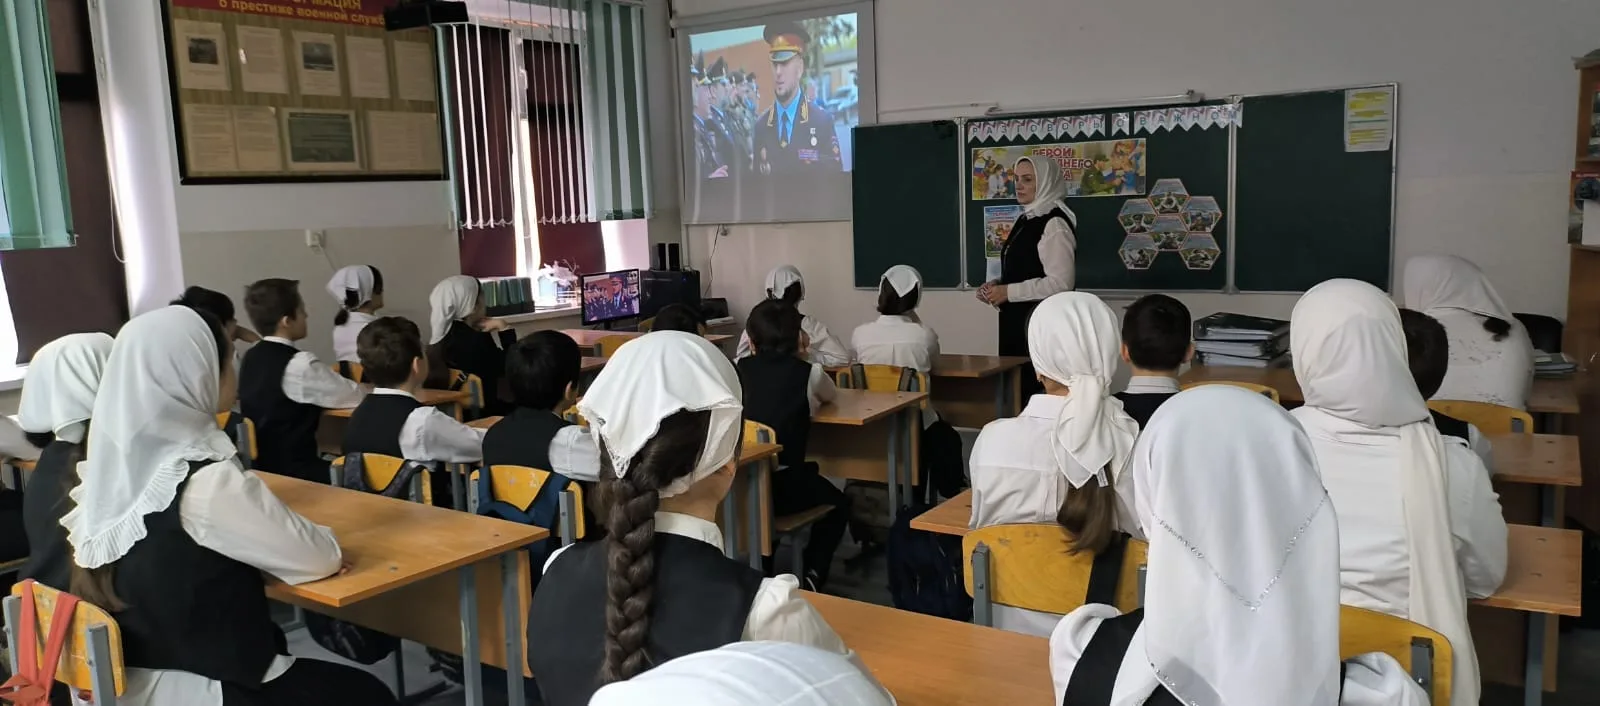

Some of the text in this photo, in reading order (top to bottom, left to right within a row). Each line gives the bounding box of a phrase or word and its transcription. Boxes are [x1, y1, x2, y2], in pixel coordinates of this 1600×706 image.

[232, 2, 293, 15] престиже
[298, 8, 348, 21] военной
[352, 13, 386, 26] служб
[972, 110, 1238, 134] РАЗГОВОРЫ О ВАЖНОМ
